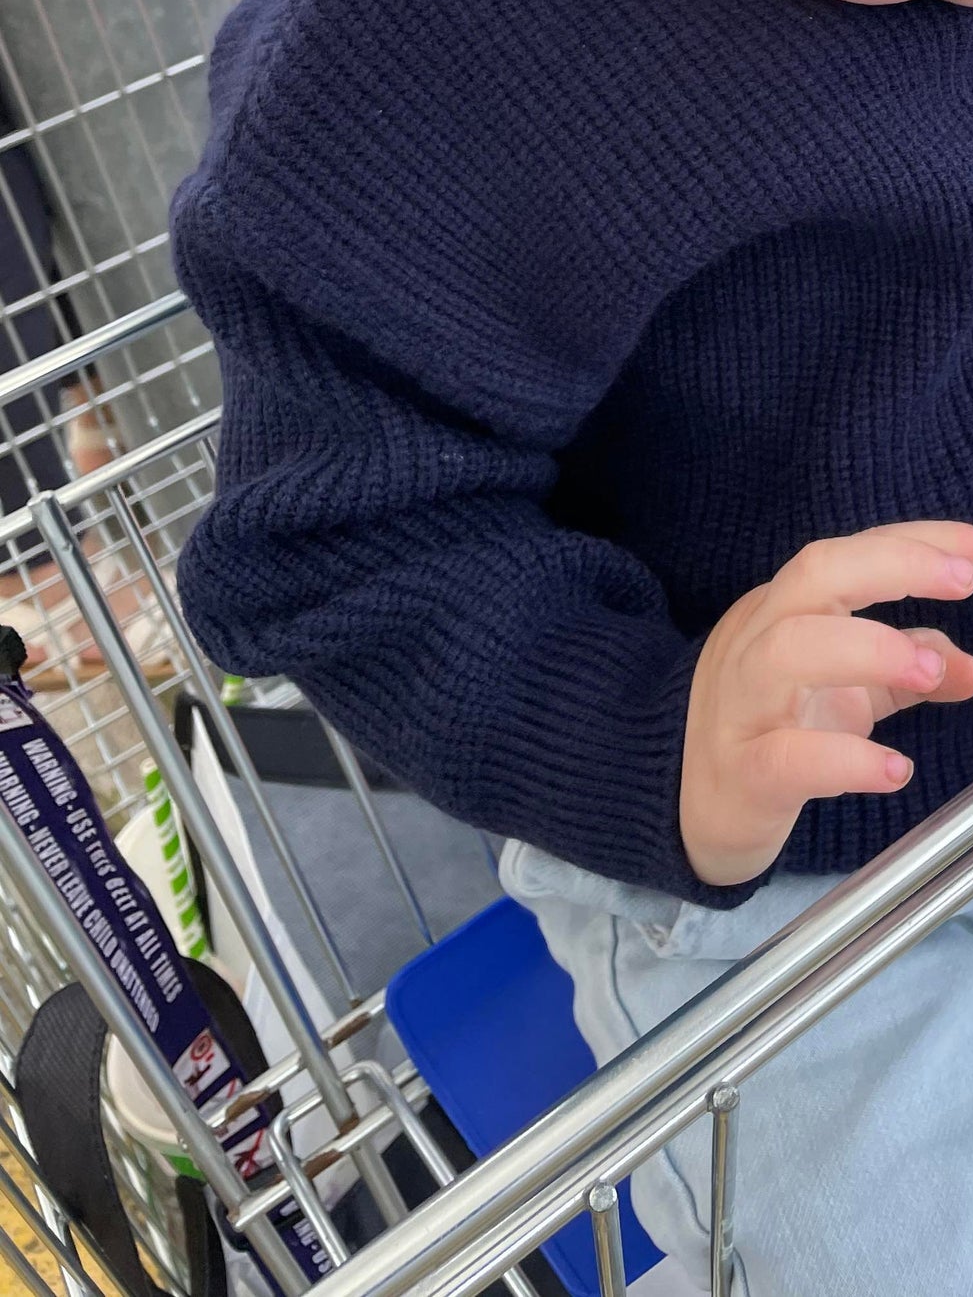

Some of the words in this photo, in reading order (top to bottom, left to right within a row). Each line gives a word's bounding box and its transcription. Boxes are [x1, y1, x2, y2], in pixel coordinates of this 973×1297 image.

[22, 737, 79, 808] WARNING
[66, 808, 98, 843] USE
[85, 839, 118, 878] THIS
[28, 825, 70, 879] NEVER
[57, 870, 94, 919] LEAVE
[83, 908, 119, 959] CHILD
[104, 875, 138, 914] BELT
[123, 906, 150, 933] AT
[134, 927, 162, 961] ALL
